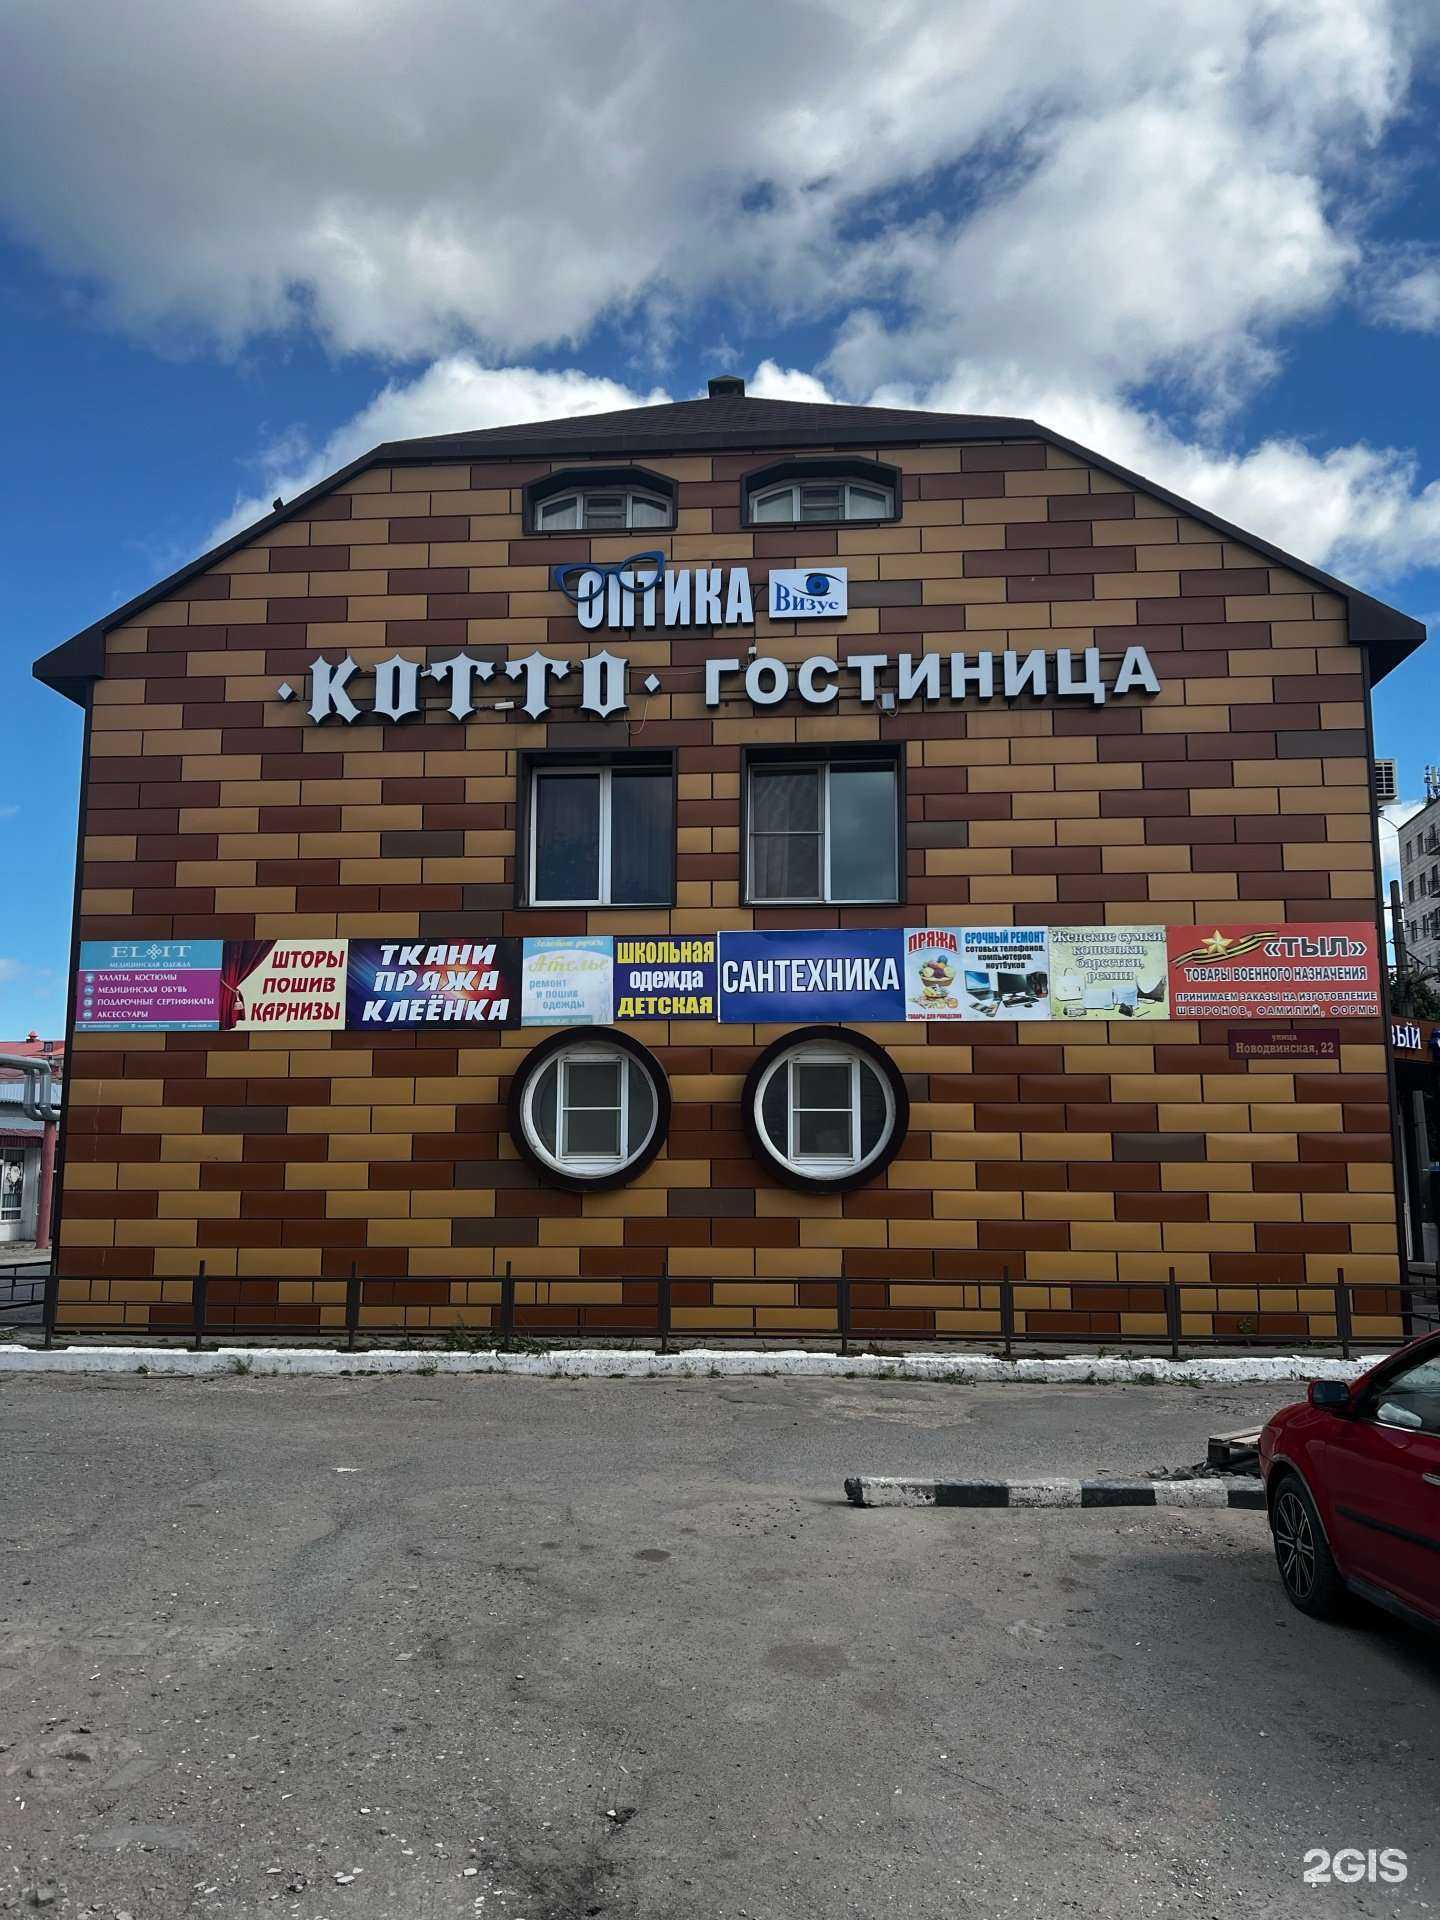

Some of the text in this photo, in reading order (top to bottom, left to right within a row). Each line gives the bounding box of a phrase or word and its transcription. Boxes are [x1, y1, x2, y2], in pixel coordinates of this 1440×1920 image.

[577, 567, 754, 629] ОПТИКА
[775, 581, 839, 614] Визус
[705, 646, 1161, 705] ГОСТИНИЦА
[307, 650, 629, 725] КОТТО
[908, 930, 958, 953] ПРЯЖА
[965, 930, 1045, 944] СРОЧНЫЙ РЕМОНТ
[1052, 930, 1117, 943] Женские
[965, 945, 998, 953] сотовых
[1263, 936, 1367, 958] «ТЫЛ»
[271, 950, 345, 969] ШТОРЫ
[380, 944, 497, 966] ТКАНИ
[985, 961, 1026, 970] ноутбуков
[134, 973, 177, 981] КОСТЮМЫ
[373, 970, 500, 992] ПРЯЖА
[722, 958, 900, 993] САНТЕХНИКА
[1185, 966, 1368, 982] ТОВАРЫ ВОЕННОГО НАЗНАЧЕНИЯ
[98, 985, 188, 994] МЕДИЦИНСКАЯ ОБУВЬ
[263, 977, 337, 995] ПОШИВ
[529, 979, 567, 991] ремонт
[97, 998, 215, 1006] ПОДАРОЧНЫЕ СЕРТИФИКАТЫ
[545, 990, 578, 999] пошив
[1176, 991, 1377, 1002] ПРИНИМАЕМ ЗАКАЗЫ НА ИЗГОТОВЛЕНИЕ
[251, 1001, 341, 1022] КАРНИЗЫ
[362, 994, 510, 1022] КЛЕЁНКА
[542, 1000, 585, 1010] одежды
[617, 996, 713, 1017] ДЕТСКАЯ
[1177, 1004, 1378, 1017] ШЕВРОНОВ, ФАМИЛИЙ, ФОРМЫ
[97, 1010, 149, 1018] АКСЕССУАРЫ
[1271, 1034, 1298, 1042] улица
[1236, 1042, 1335, 1055] Новодвинская, 22
